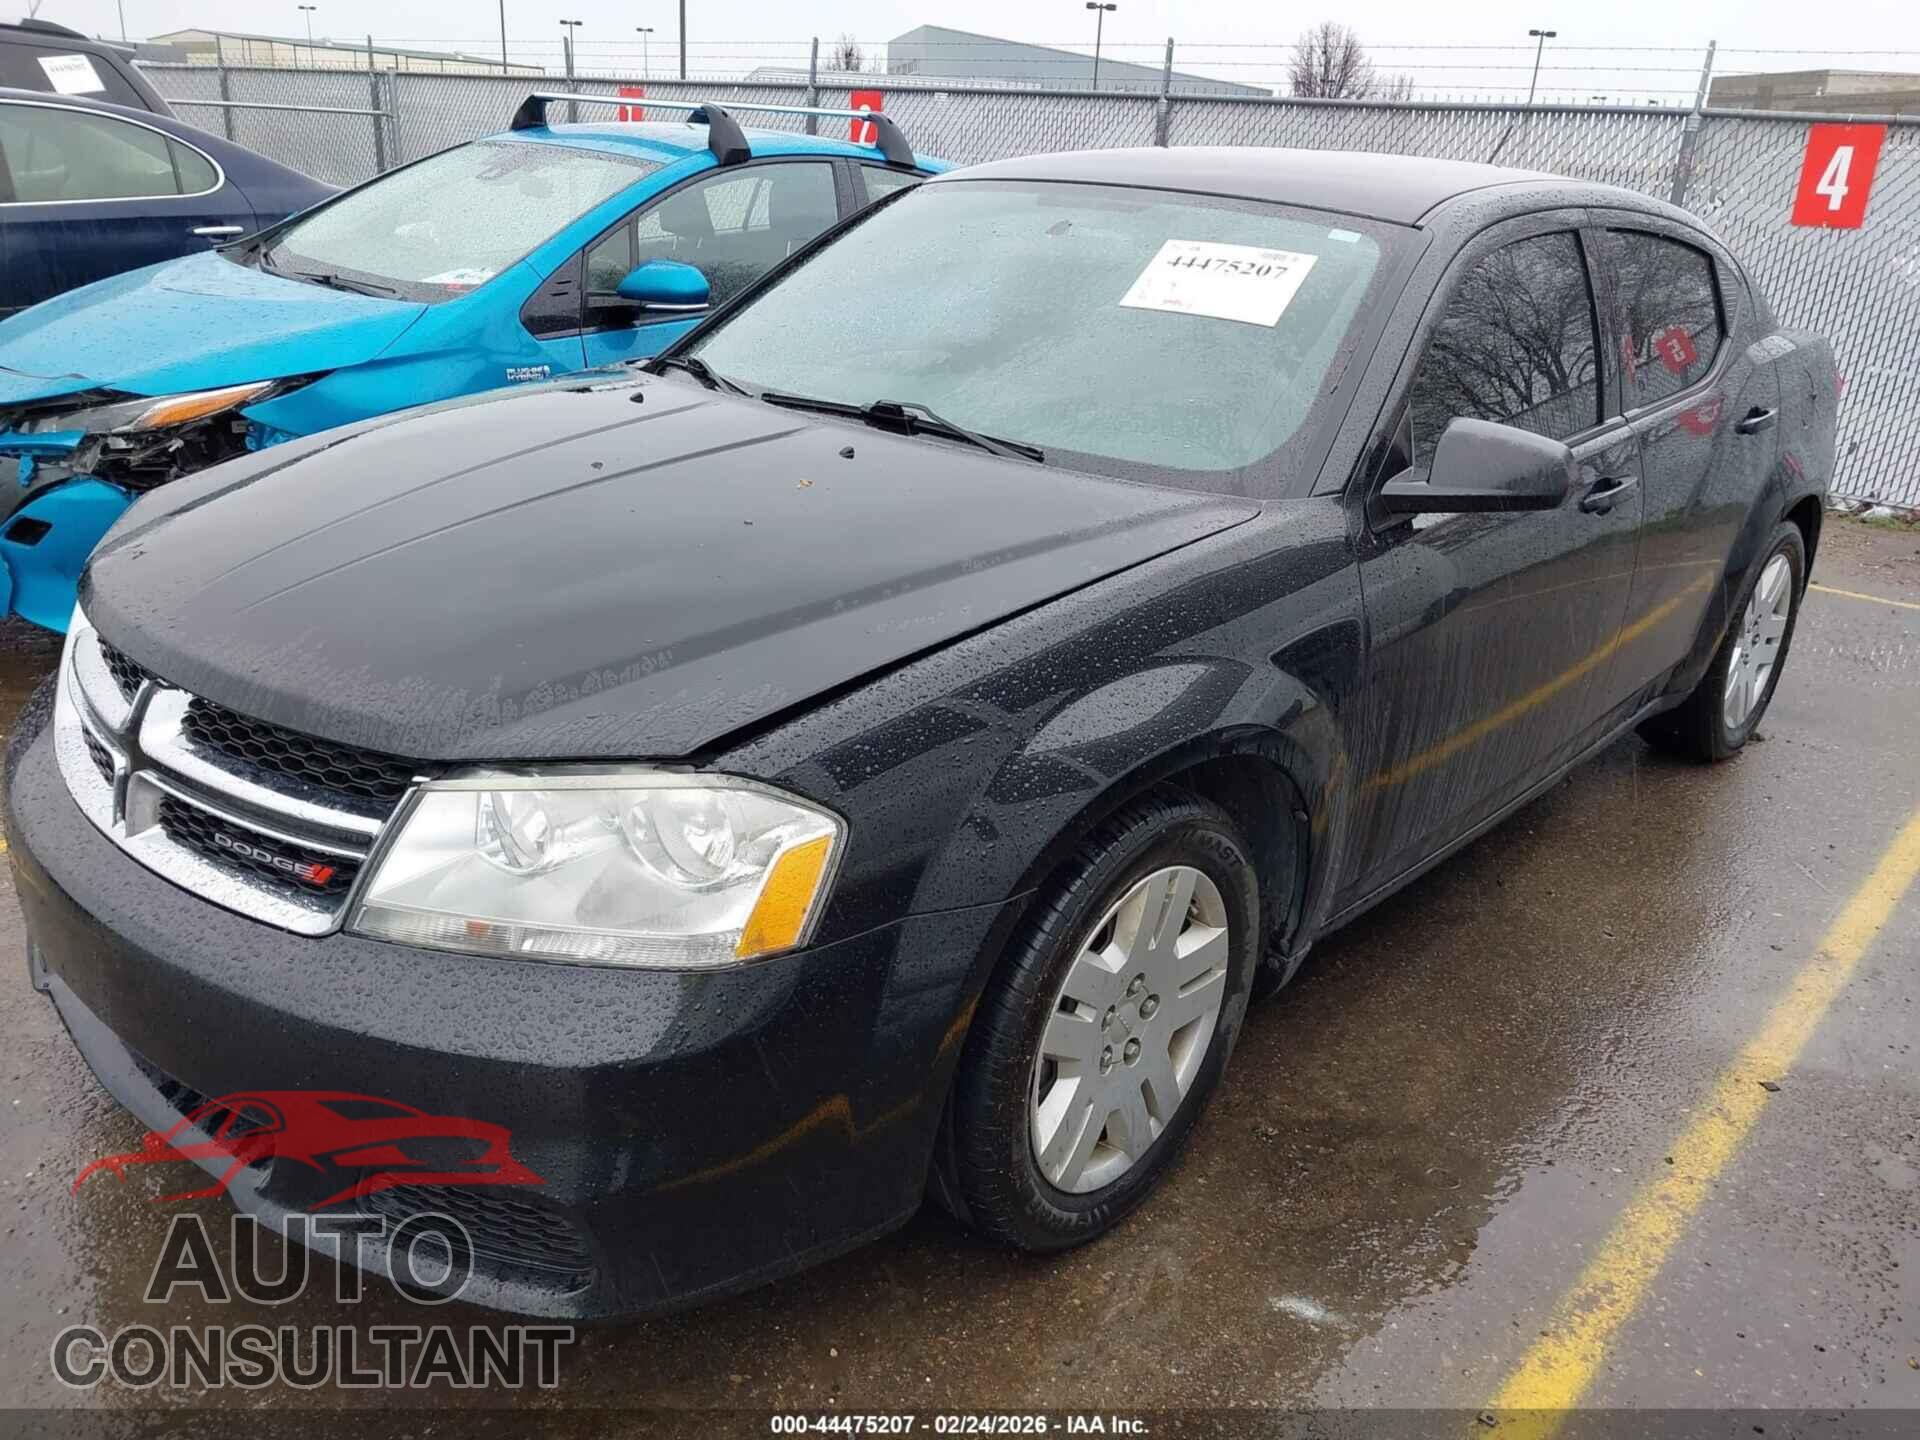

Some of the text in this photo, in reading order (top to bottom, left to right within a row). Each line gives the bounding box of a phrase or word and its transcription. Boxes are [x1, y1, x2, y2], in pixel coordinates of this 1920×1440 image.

[1816, 146, 1854, 211] 4
[1167, 255, 1289, 279] 44475207
[214, 832, 314, 880] DODGE
